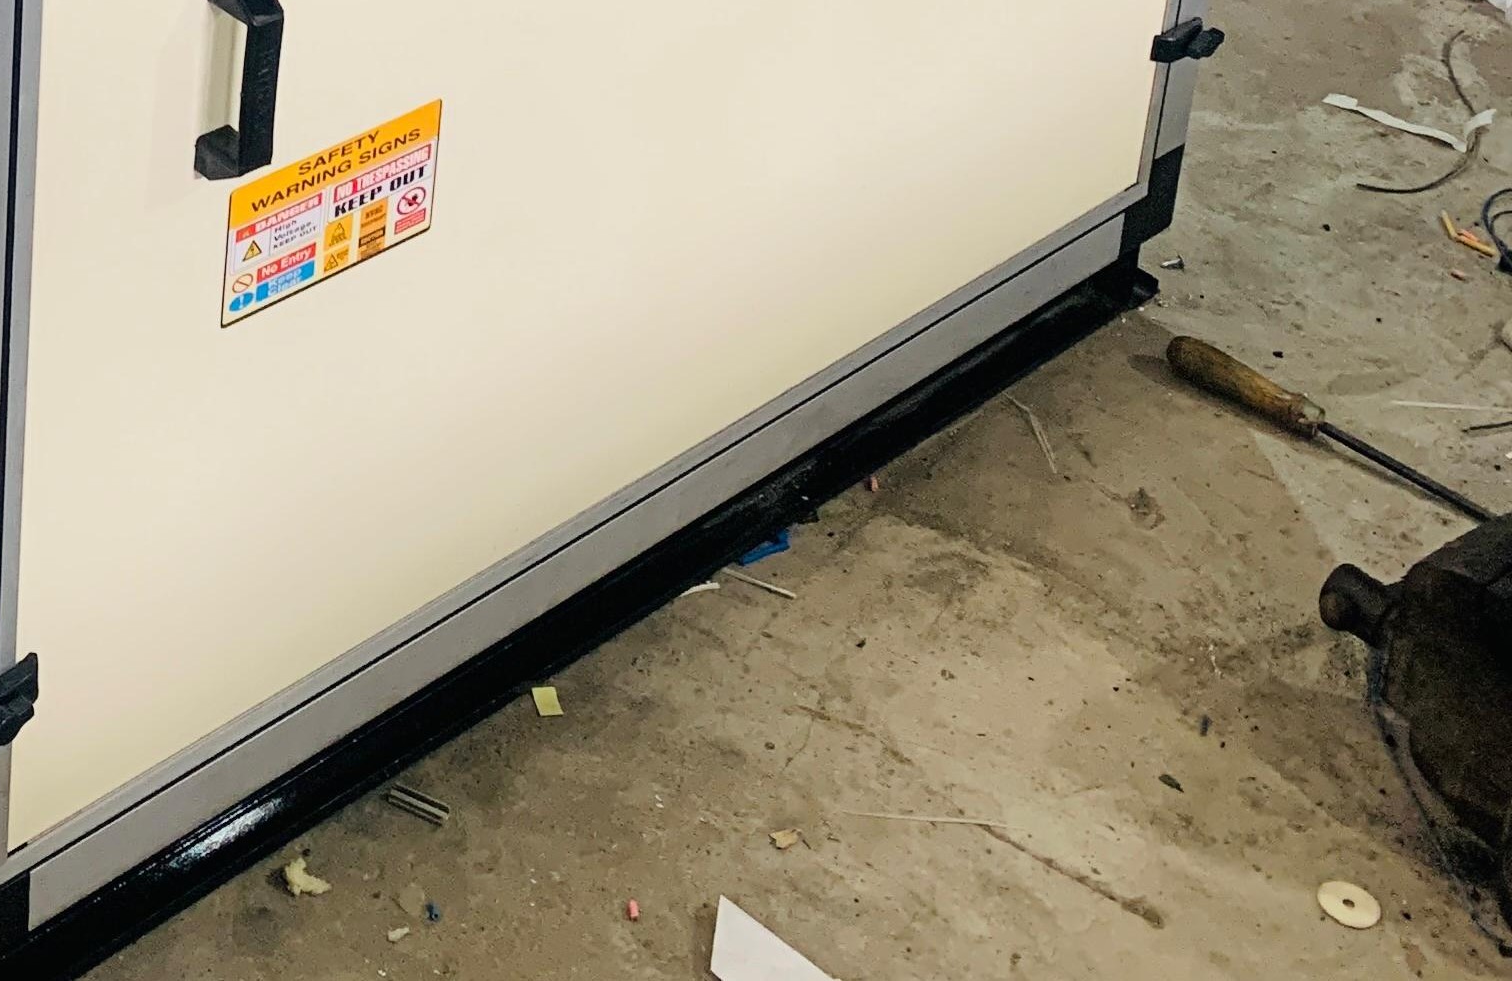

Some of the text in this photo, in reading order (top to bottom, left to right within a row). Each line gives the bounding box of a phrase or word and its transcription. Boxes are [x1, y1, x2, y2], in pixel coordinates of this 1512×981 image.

[252, 129, 420, 212] WARNING SIGNS
[299, 131, 379, 175] SAFETY
[335, 186, 382, 217] KEEP
[390, 165, 425, 191] OUT
[337, 147, 428, 200] NO TRESPASSING
[256, 196, 318, 232] DANGER
[274, 222, 311, 241] Voltage
[275, 220, 297, 233] High
[274, 226, 316, 249] KEEP OUT
[262, 248, 311, 278] No Entry
